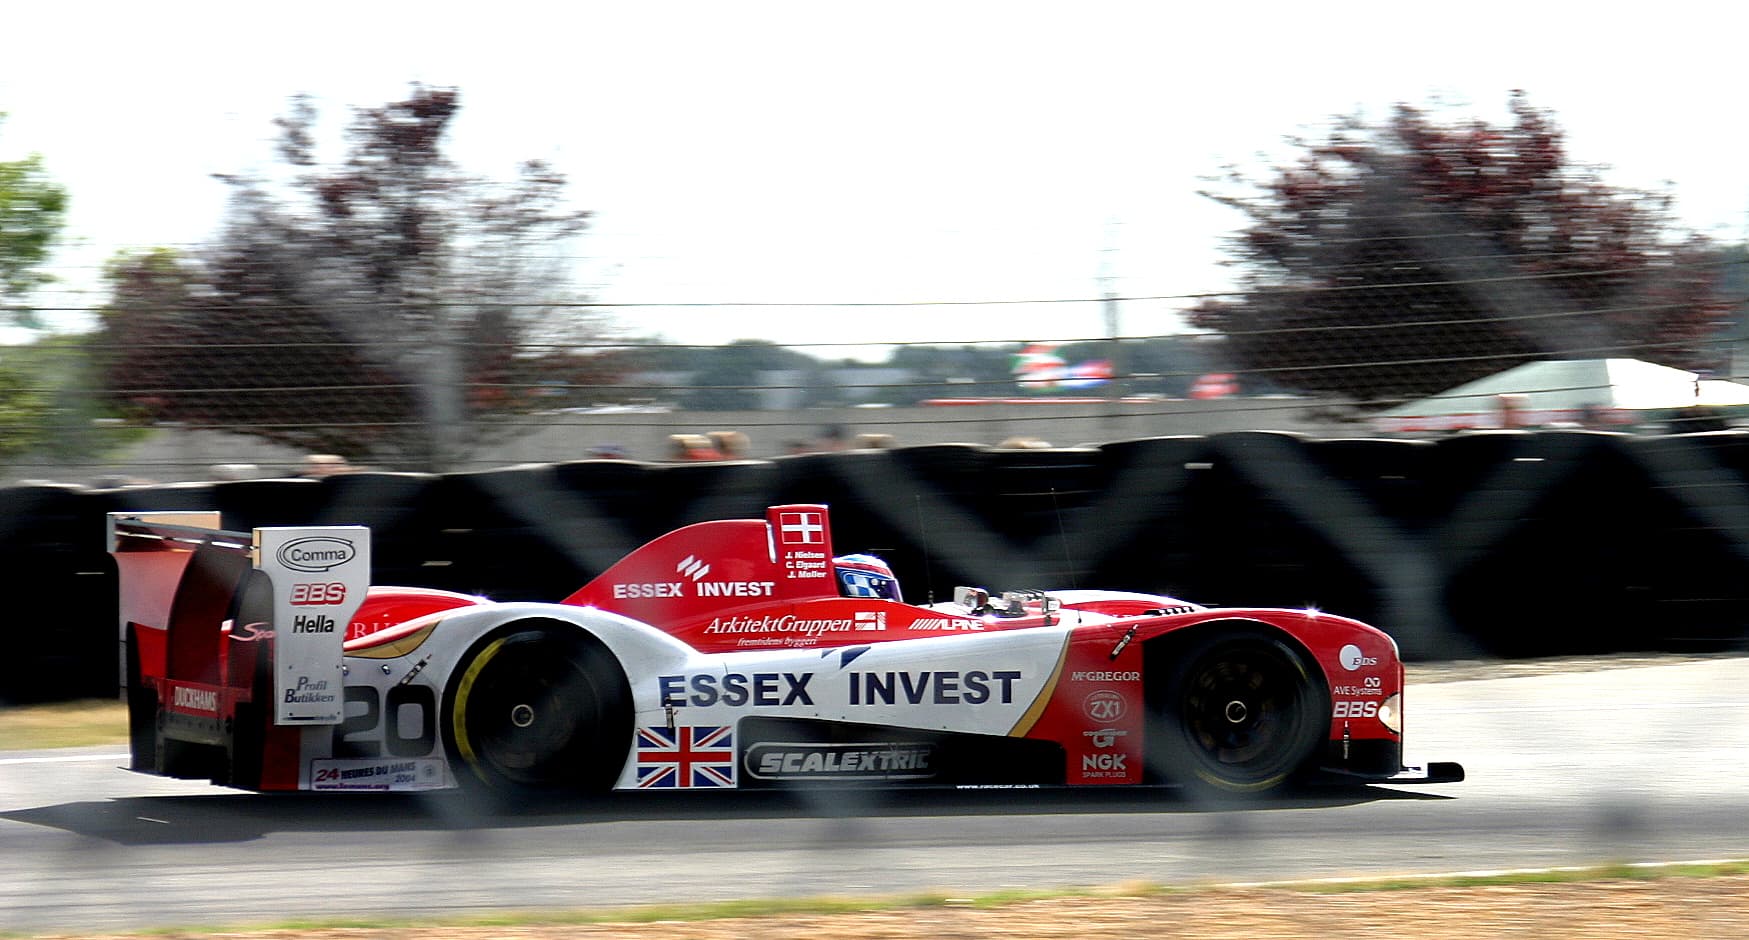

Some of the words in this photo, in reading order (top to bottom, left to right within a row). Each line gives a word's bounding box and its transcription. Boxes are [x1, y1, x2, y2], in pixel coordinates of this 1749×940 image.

[291, 548, 346, 561] Comma
[795, 551, 825, 559] Nielsen
[786, 561, 794, 569] C.
[289, 582, 346, 606] BBS
[613, 582, 684, 599] ESSEX
[697, 581, 775, 597] INVEST
[293, 615, 335, 634] Hella
[704, 614, 851, 637] ArkitektGruppen
[936, 619, 985, 631] ALPINE
[1352, 657, 1378, 666] EDS
[297, 676, 328, 692] Profil
[1071, 671, 1140, 681] McGREGOR
[284, 688, 335, 704] Butikken
[658, 672, 815, 708] ESSEX
[849, 670, 1022, 706] INVEST
[174, 685, 218, 712] DUCKHAMS
[1090, 700, 1120, 719] ZX1
[1332, 701, 1378, 719] BBS
[332, 684, 437, 758] 20
[758, 751, 930, 773] SCALEXTRIC
[1082, 754, 1127, 771] NGK
[315, 768, 340, 782] 24
[340, 767, 375, 780] HEURES
[375, 765, 389, 776] DU
